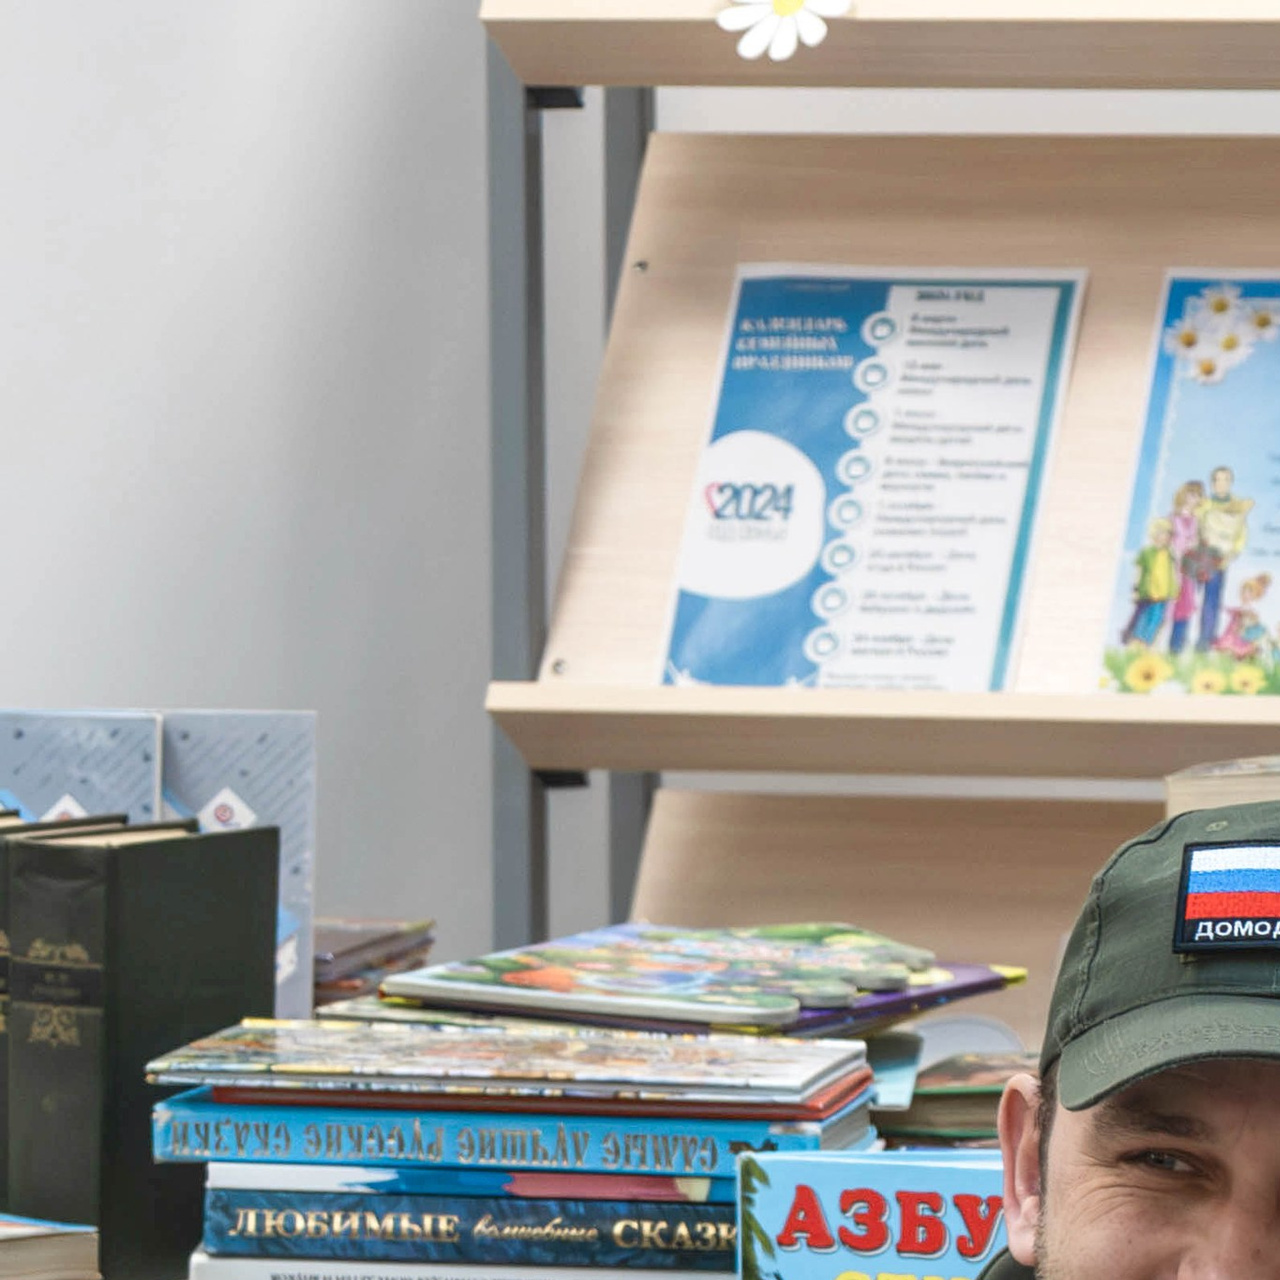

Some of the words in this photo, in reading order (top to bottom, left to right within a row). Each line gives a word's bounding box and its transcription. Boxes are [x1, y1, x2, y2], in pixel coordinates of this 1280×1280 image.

[714, 482, 794, 521] 2024
[171, 1117, 292, 1158] СКАЗКИ
[303, 1118, 445, 1163] РУССКИЕ
[457, 1122, 590, 1169] ЛУЧШИЕ
[603, 1131, 719, 1174] САМЫЕ
[228, 1207, 461, 1244] ЛЮБИМЫЕ
[611, 1219, 738, 1250] СКАЗК
[776, 1184, 1004, 1260] АЗБУ
